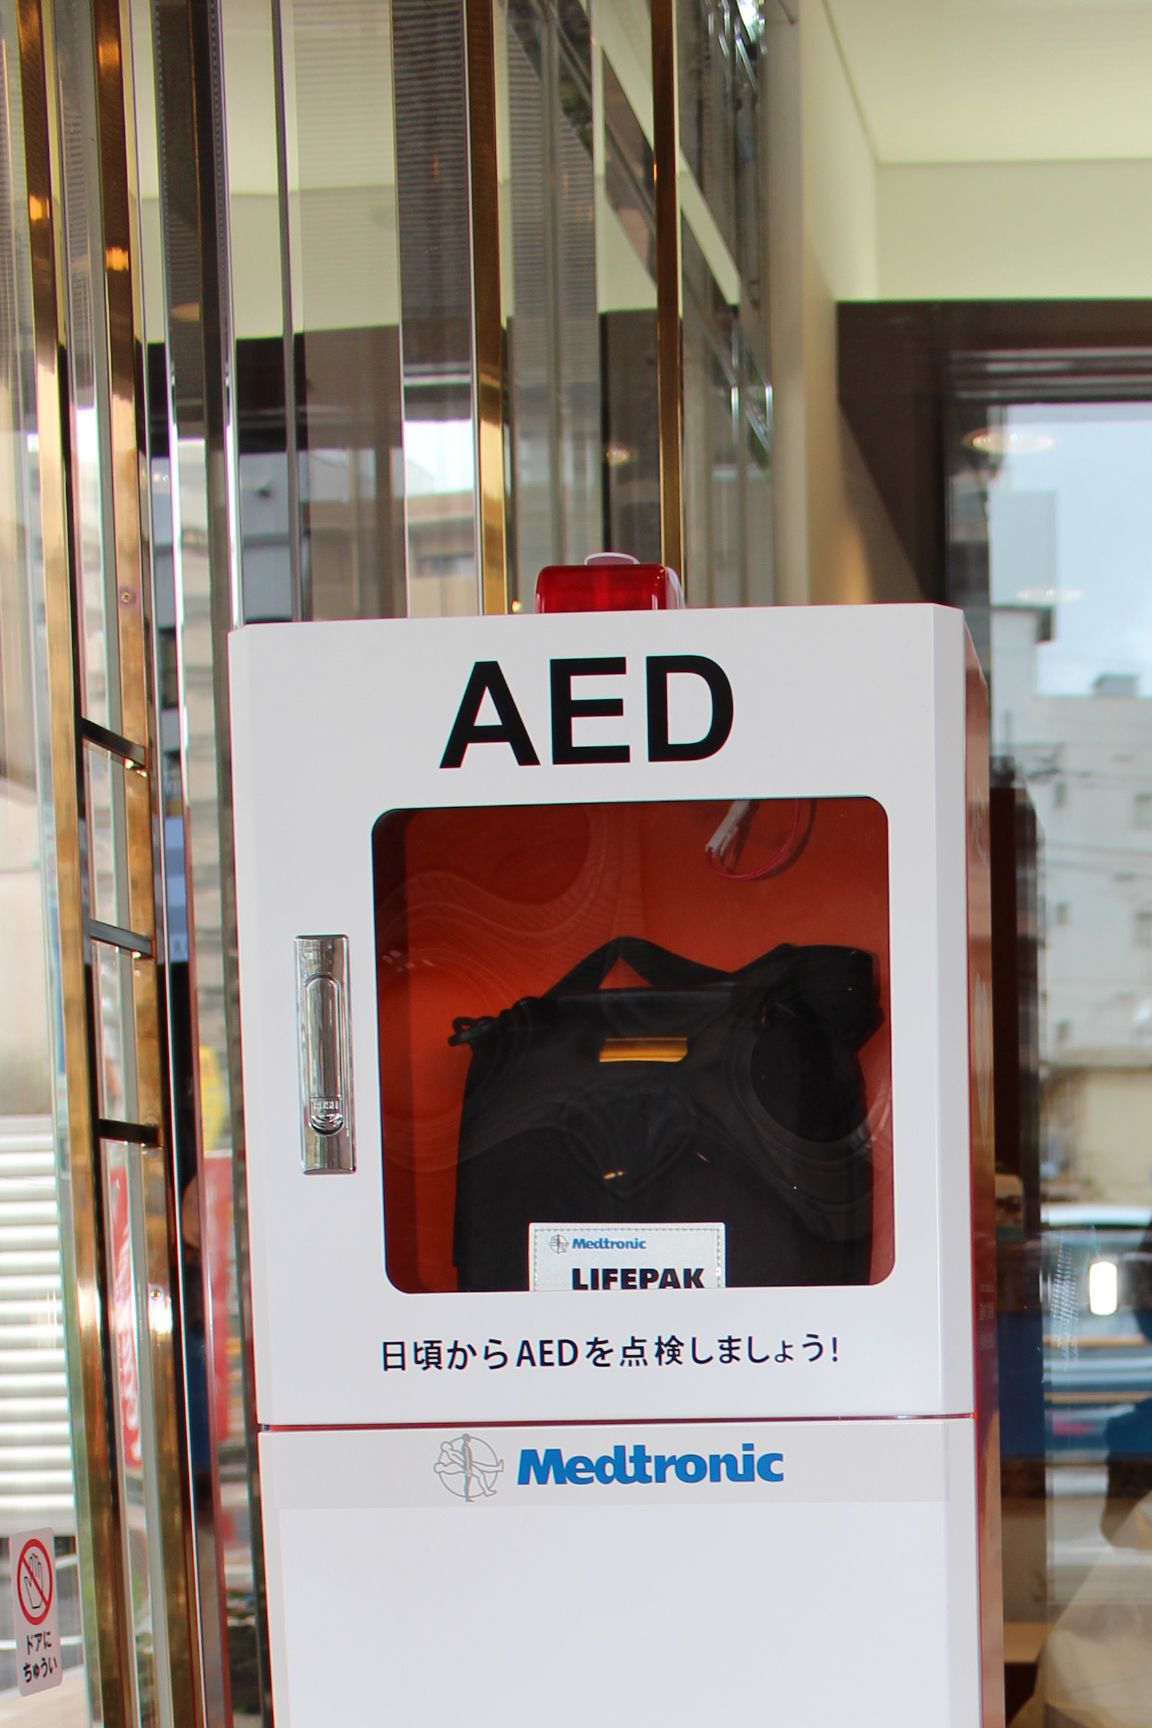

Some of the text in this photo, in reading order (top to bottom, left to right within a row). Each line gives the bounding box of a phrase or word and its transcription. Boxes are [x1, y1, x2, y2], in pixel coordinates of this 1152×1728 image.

[438, 653, 734, 769] AED
[571, 1237, 647, 1250] Medtronic
[571, 1267, 705, 1291] LIFEPAK
[517, 1442, 785, 1486] Medtronic
[26, 1630, 52, 1655] ドアに
[23, 1656, 58, 1684] ちゅうい
